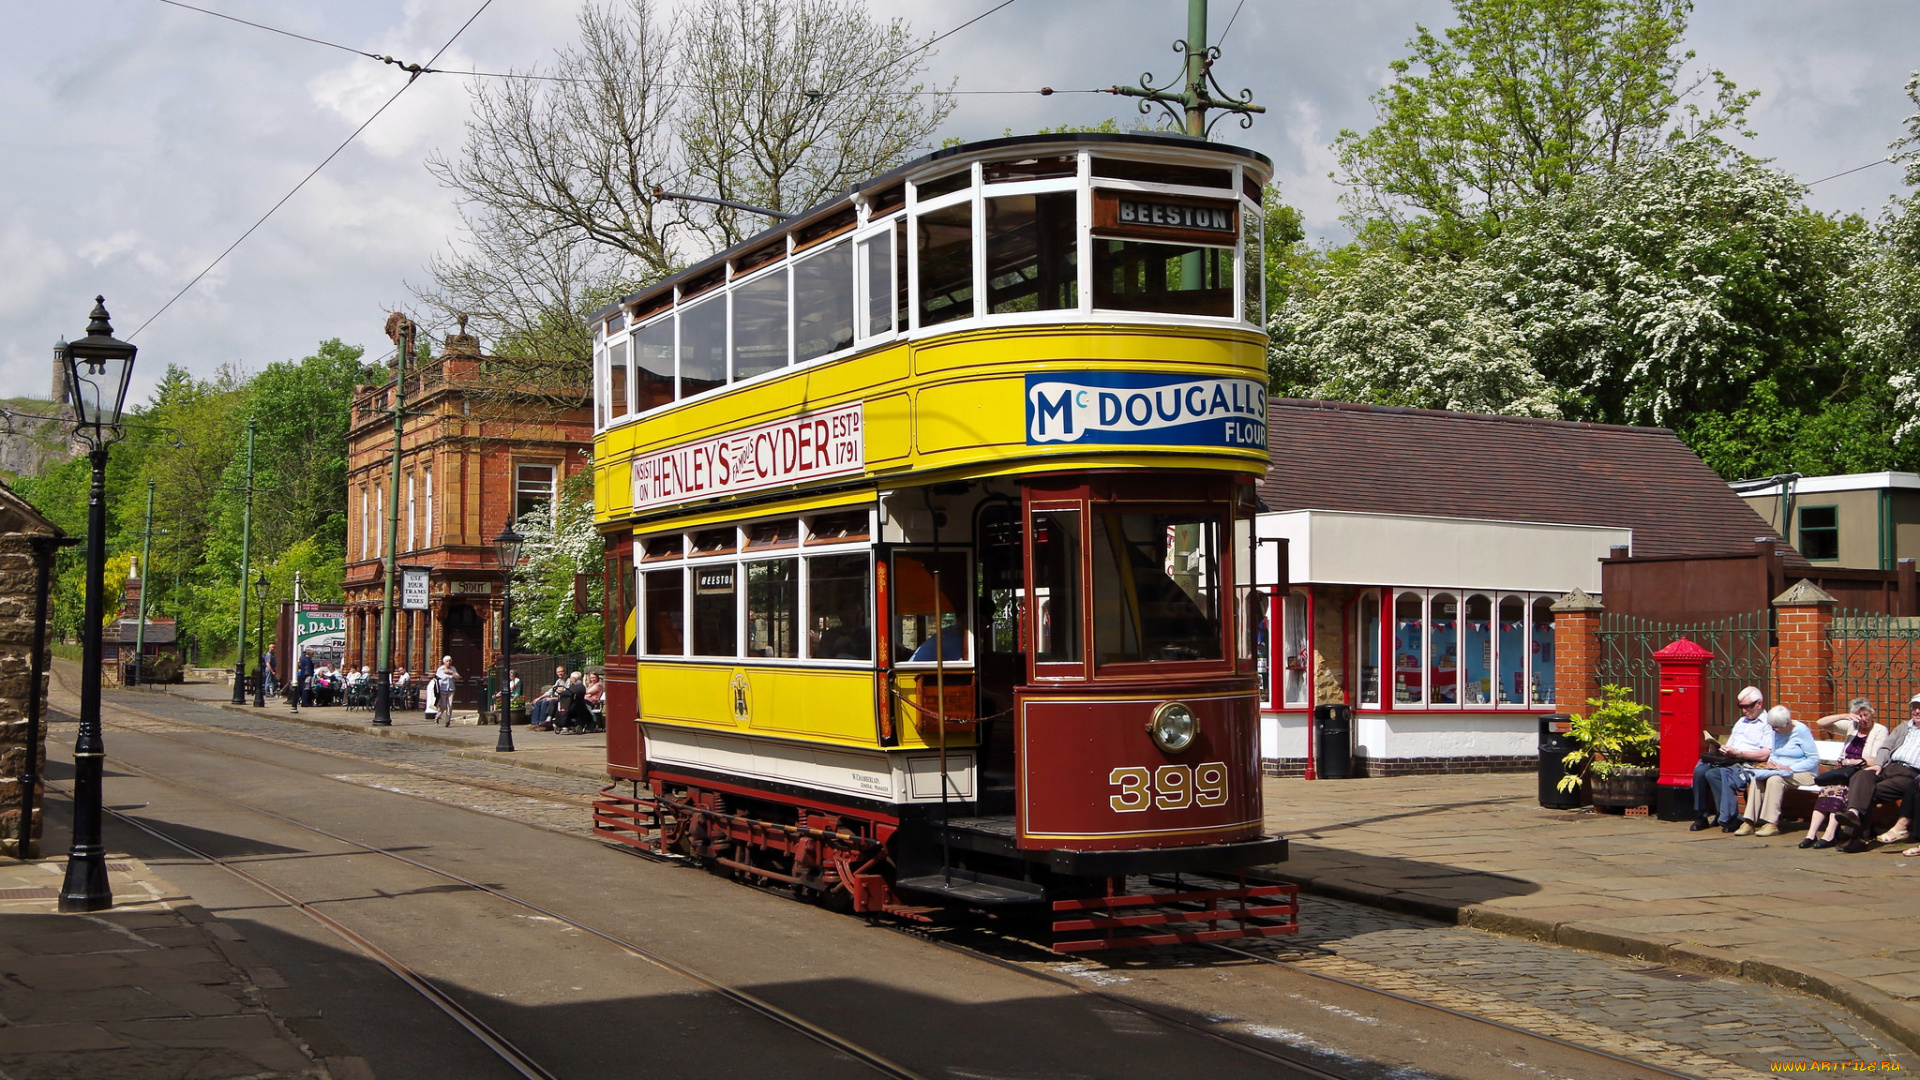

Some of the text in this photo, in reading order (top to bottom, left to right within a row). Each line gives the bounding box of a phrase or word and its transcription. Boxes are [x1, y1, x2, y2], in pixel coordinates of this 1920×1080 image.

[1121, 202, 1226, 228] BEESTON
[1225, 421, 1267, 447] FLOUR
[653, 419, 831, 498] HENLEY'S FAMOUS CYDER
[836, 440, 858, 465] 1791
[634, 460, 653, 482] INSIST
[639, 483, 649, 501] ON
[1109, 761, 1229, 813] 399
